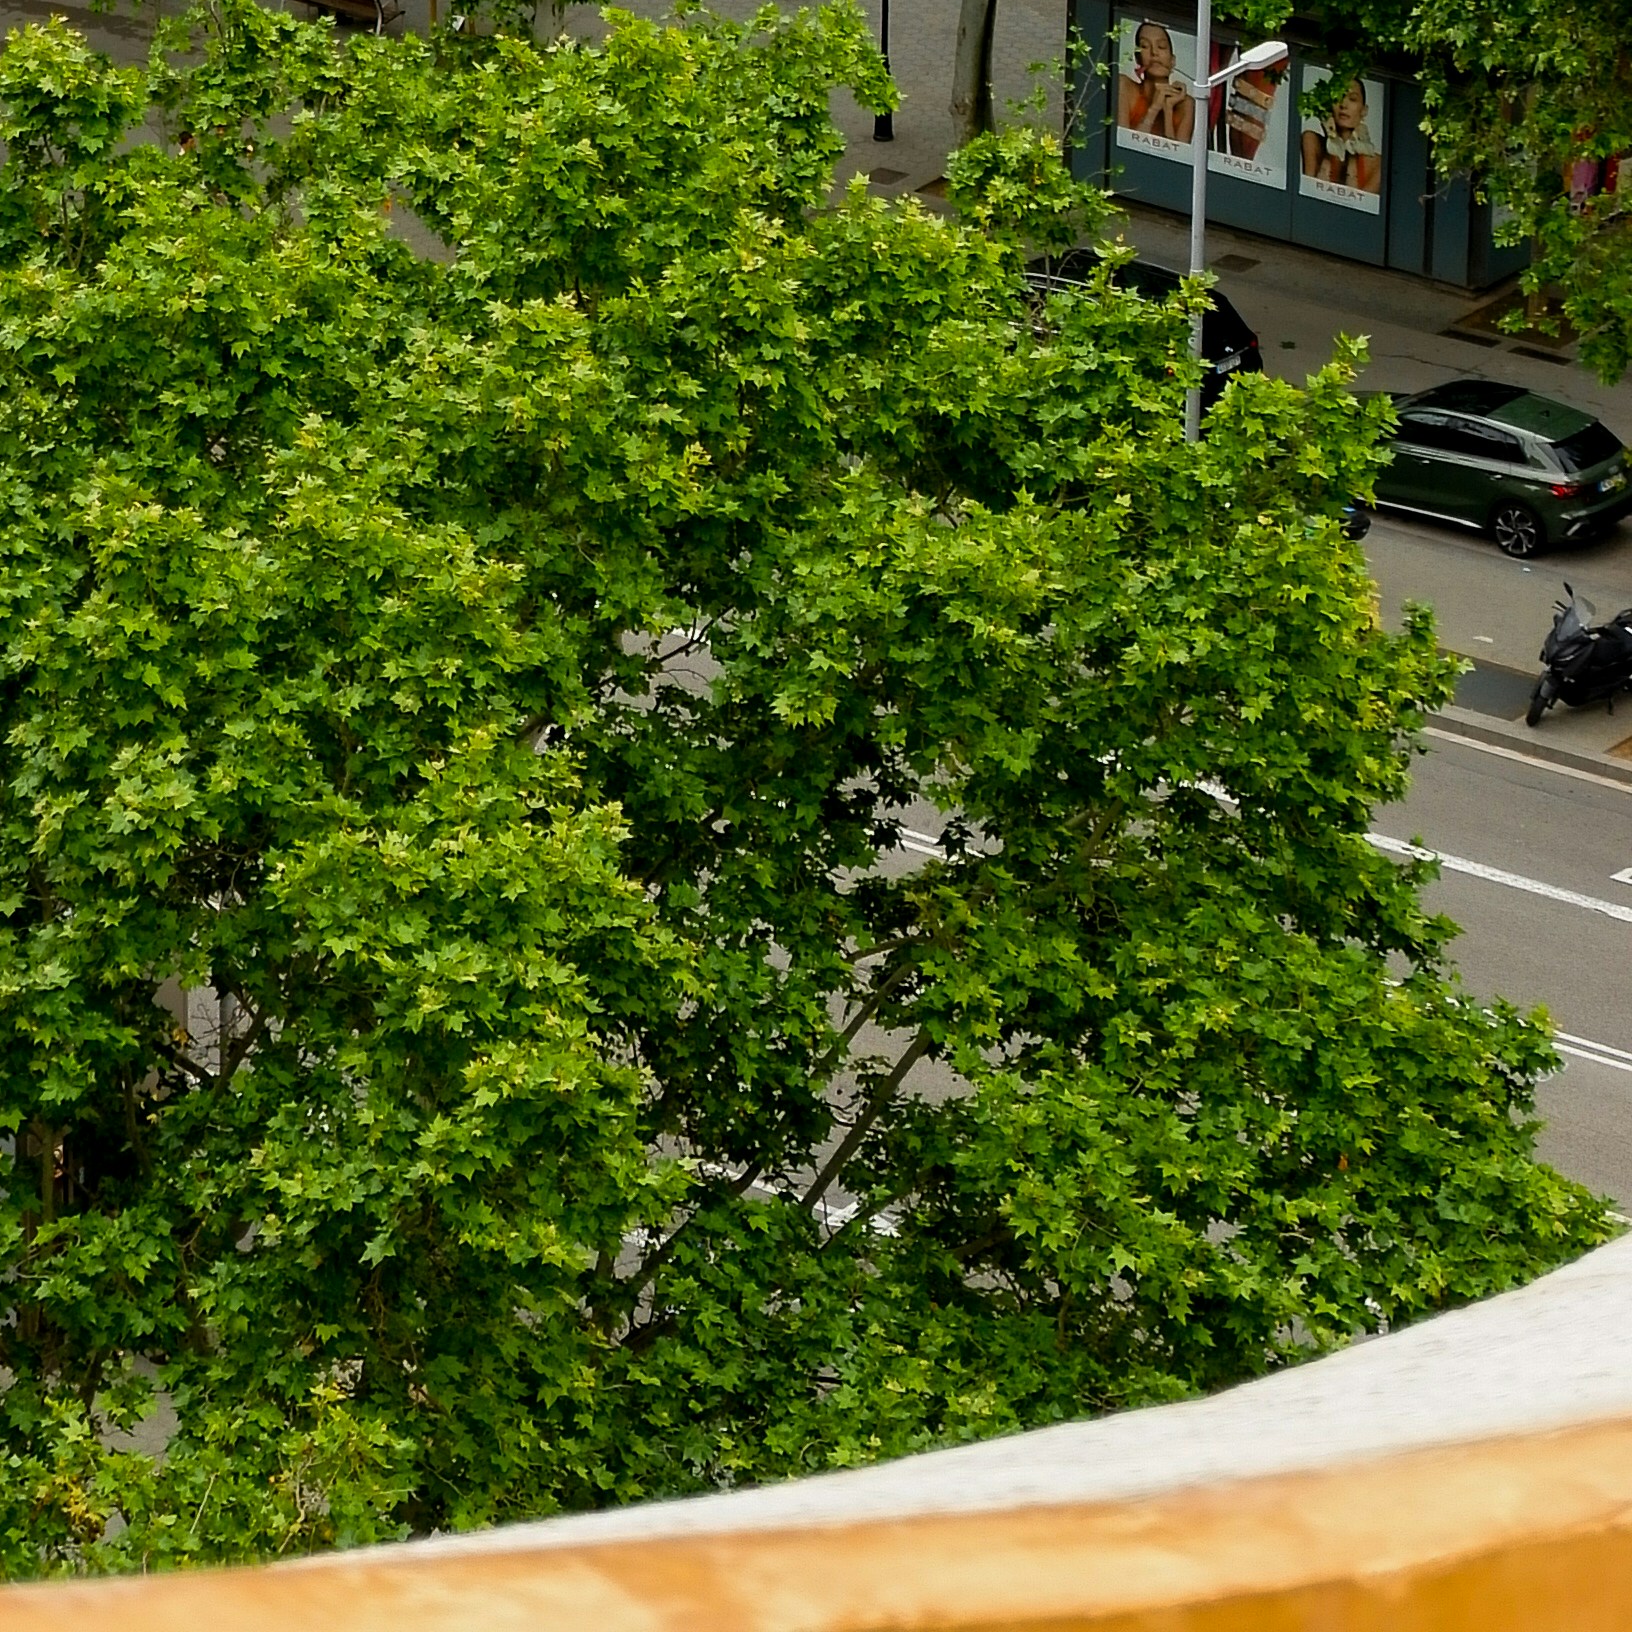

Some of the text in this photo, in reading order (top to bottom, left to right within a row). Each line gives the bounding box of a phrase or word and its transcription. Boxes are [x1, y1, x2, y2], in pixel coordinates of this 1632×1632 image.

[1131, 133, 1180, 152] RABAT
[1223, 156, 1273, 176] RABAT
[1316, 182, 1366, 202] RABAT
